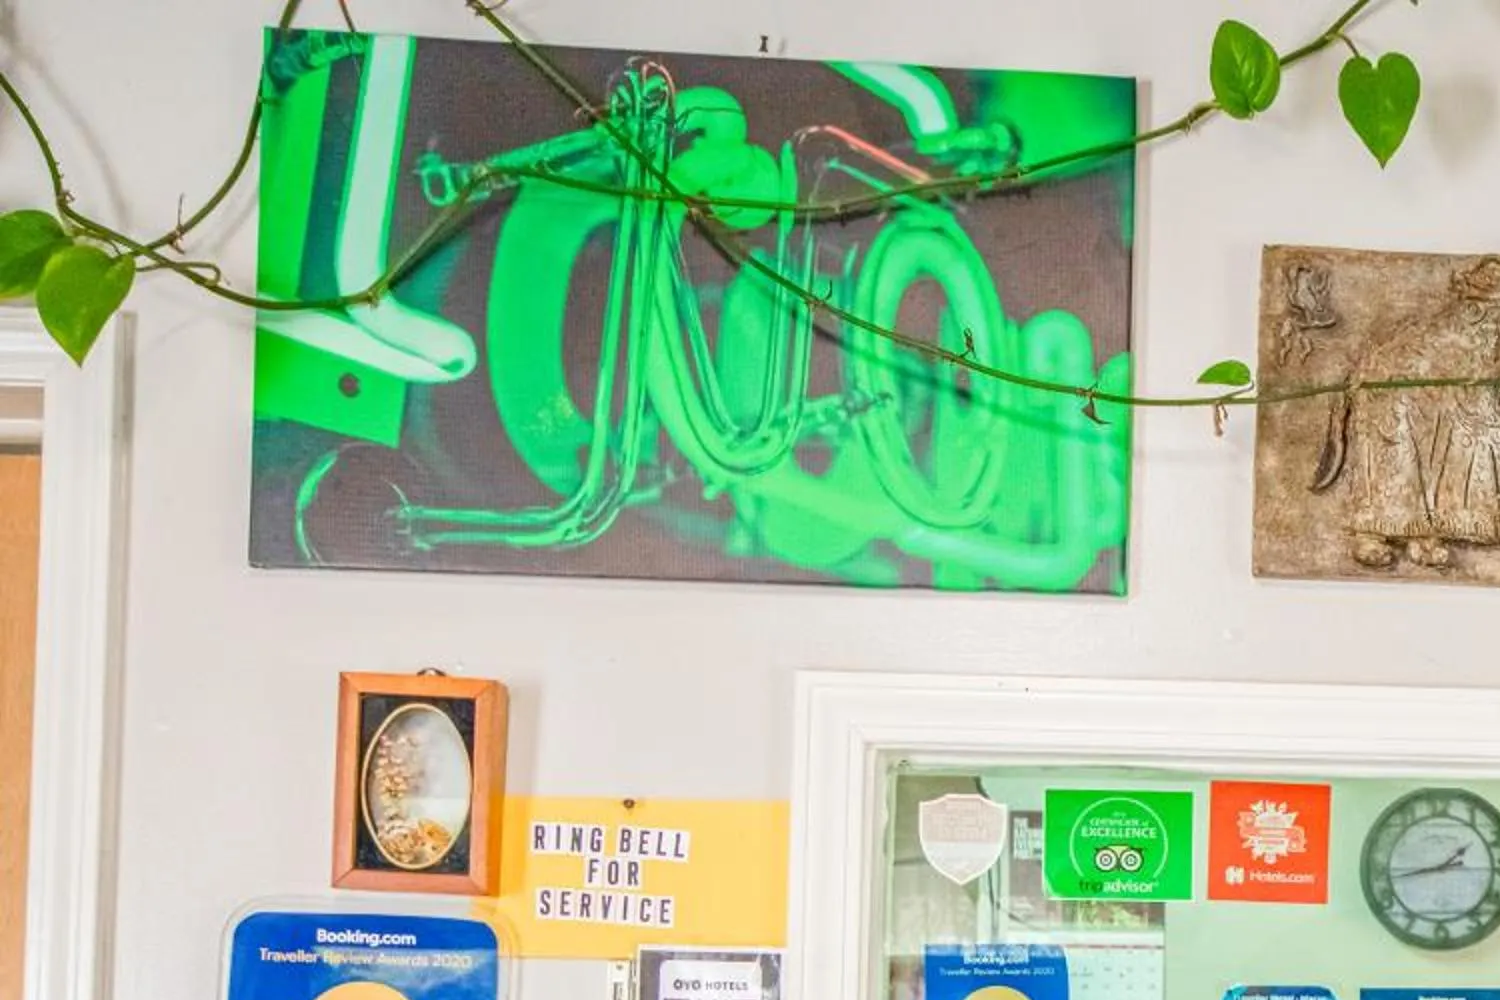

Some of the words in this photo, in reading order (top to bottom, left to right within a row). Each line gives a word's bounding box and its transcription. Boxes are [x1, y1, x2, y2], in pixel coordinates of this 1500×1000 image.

[534, 825, 602, 853] RING
[619, 828, 685, 858] BELL
[1081, 827, 1157, 838] EXCELLENCE
[588, 859, 640, 886] FOR
[540, 890, 672, 924] SERVICE
[316, 928, 417, 947] Booking.com
[323, 949, 376, 967] Review
[377, 952, 430, 967] Awards
[431, 953, 474, 969] 2020
[705, 980, 749, 991] HOTELS
